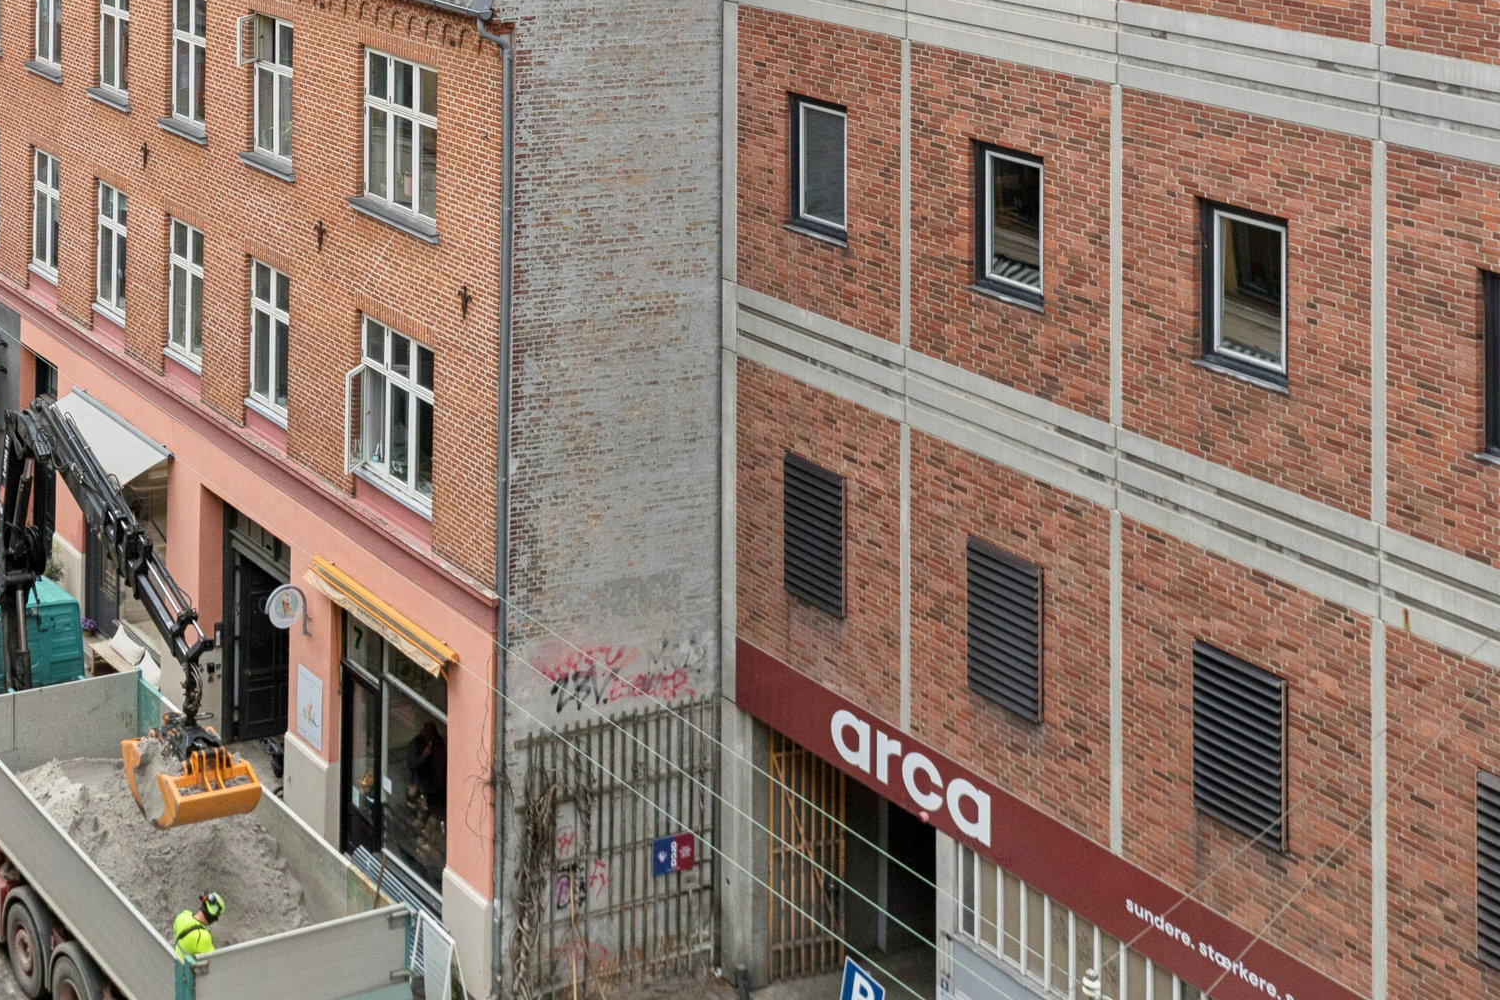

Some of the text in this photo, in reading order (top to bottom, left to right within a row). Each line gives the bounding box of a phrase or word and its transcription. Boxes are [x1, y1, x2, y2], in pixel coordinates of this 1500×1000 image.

[354, 625, 363, 650] 7
[830, 709, 991, 849] arca
[1125, 898, 1282, 1000] sundere. stærkere.
